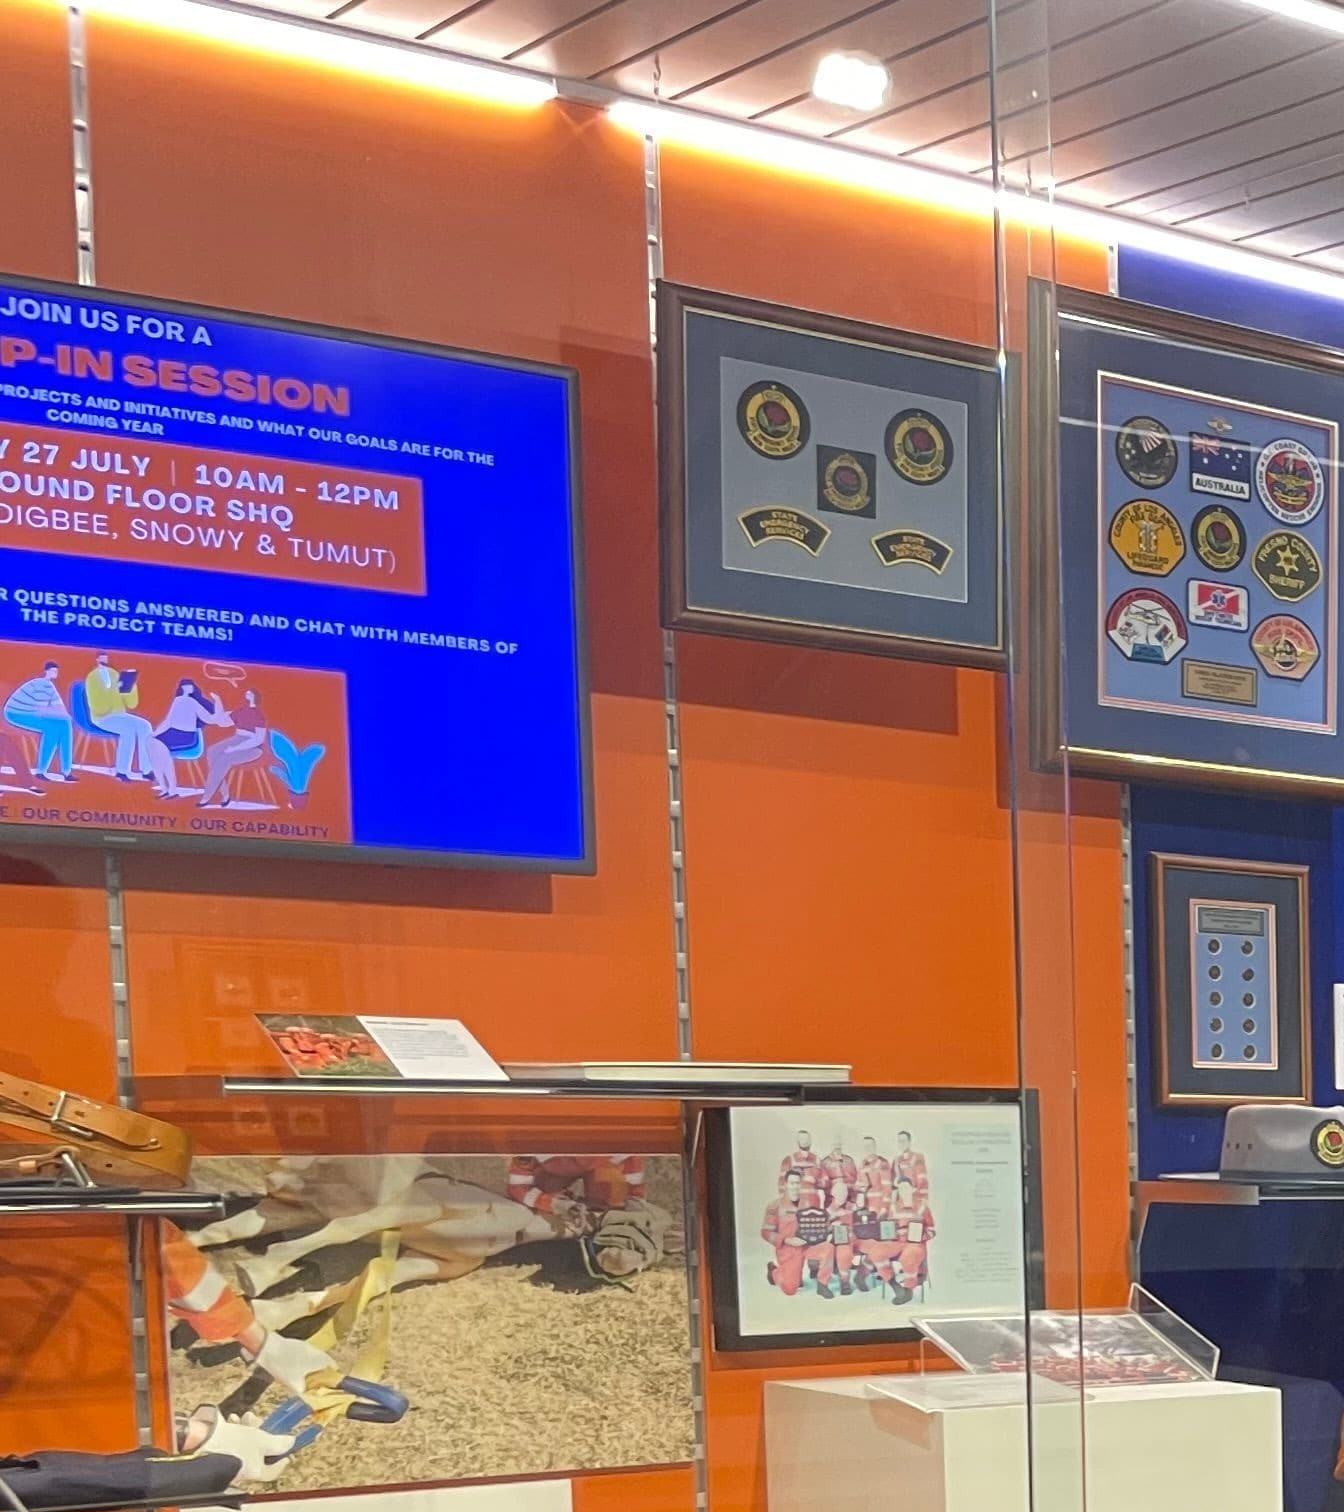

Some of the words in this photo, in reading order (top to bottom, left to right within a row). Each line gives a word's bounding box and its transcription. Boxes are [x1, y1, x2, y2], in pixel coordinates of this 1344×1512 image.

[1, 296, 72, 325] JOIN
[80, 307, 119, 332] US
[126, 314, 185, 342] FOR
[192, 326, 212, 346] A
[122, 354, 350, 417] SESSION
[46, 409, 118, 429] COMING
[121, 419, 164, 436] YEAR
[86, 396, 121, 411] AND
[124, 400, 216, 425] INITIATIVES
[220, 414, 254, 430] AND
[257, 419, 304, 437] WHAT
[308, 427, 342, 443] OUR
[346, 433, 398, 451] GOALS
[401, 441, 431, 457] ARE
[434, 446, 464, 462] FOR
[467, 451, 494, 466] THE
[23, 441, 59, 465] 27
[71, 448, 150, 477] JULY
[195, 464, 284, 495] 10AM
[317, 481, 399, 511] 12PM
[1195, 477, 1246, 495] AUSTRALIA
[106, 484, 216, 518] FLOOR
[226, 498, 294, 532] SHQ
[130, 518, 244, 551] SNOWY
[256, 534, 277, 555] &
[288, 537, 396, 574] TUMUT)
[14, 589, 130, 613] QUESTIONS
[135, 602, 244, 625] ANSWERED
[250, 613, 289, 630] AND
[294, 618, 345, 636] CHAT
[350, 624, 398, 642] WITH
[403, 630, 490, 652] MEMBERS
[495, 641, 518, 655] OF
[21, 607, 59, 624] THE
[64, 612, 156, 633] PROJECT
[162, 621, 233, 642] TEAMS!
[23, 807, 61, 820] OUR
[66, 809, 177, 828] COMMUNITY
[191, 818, 227, 832] OUR
[232, 821, 329, 838] CAPABILITY
